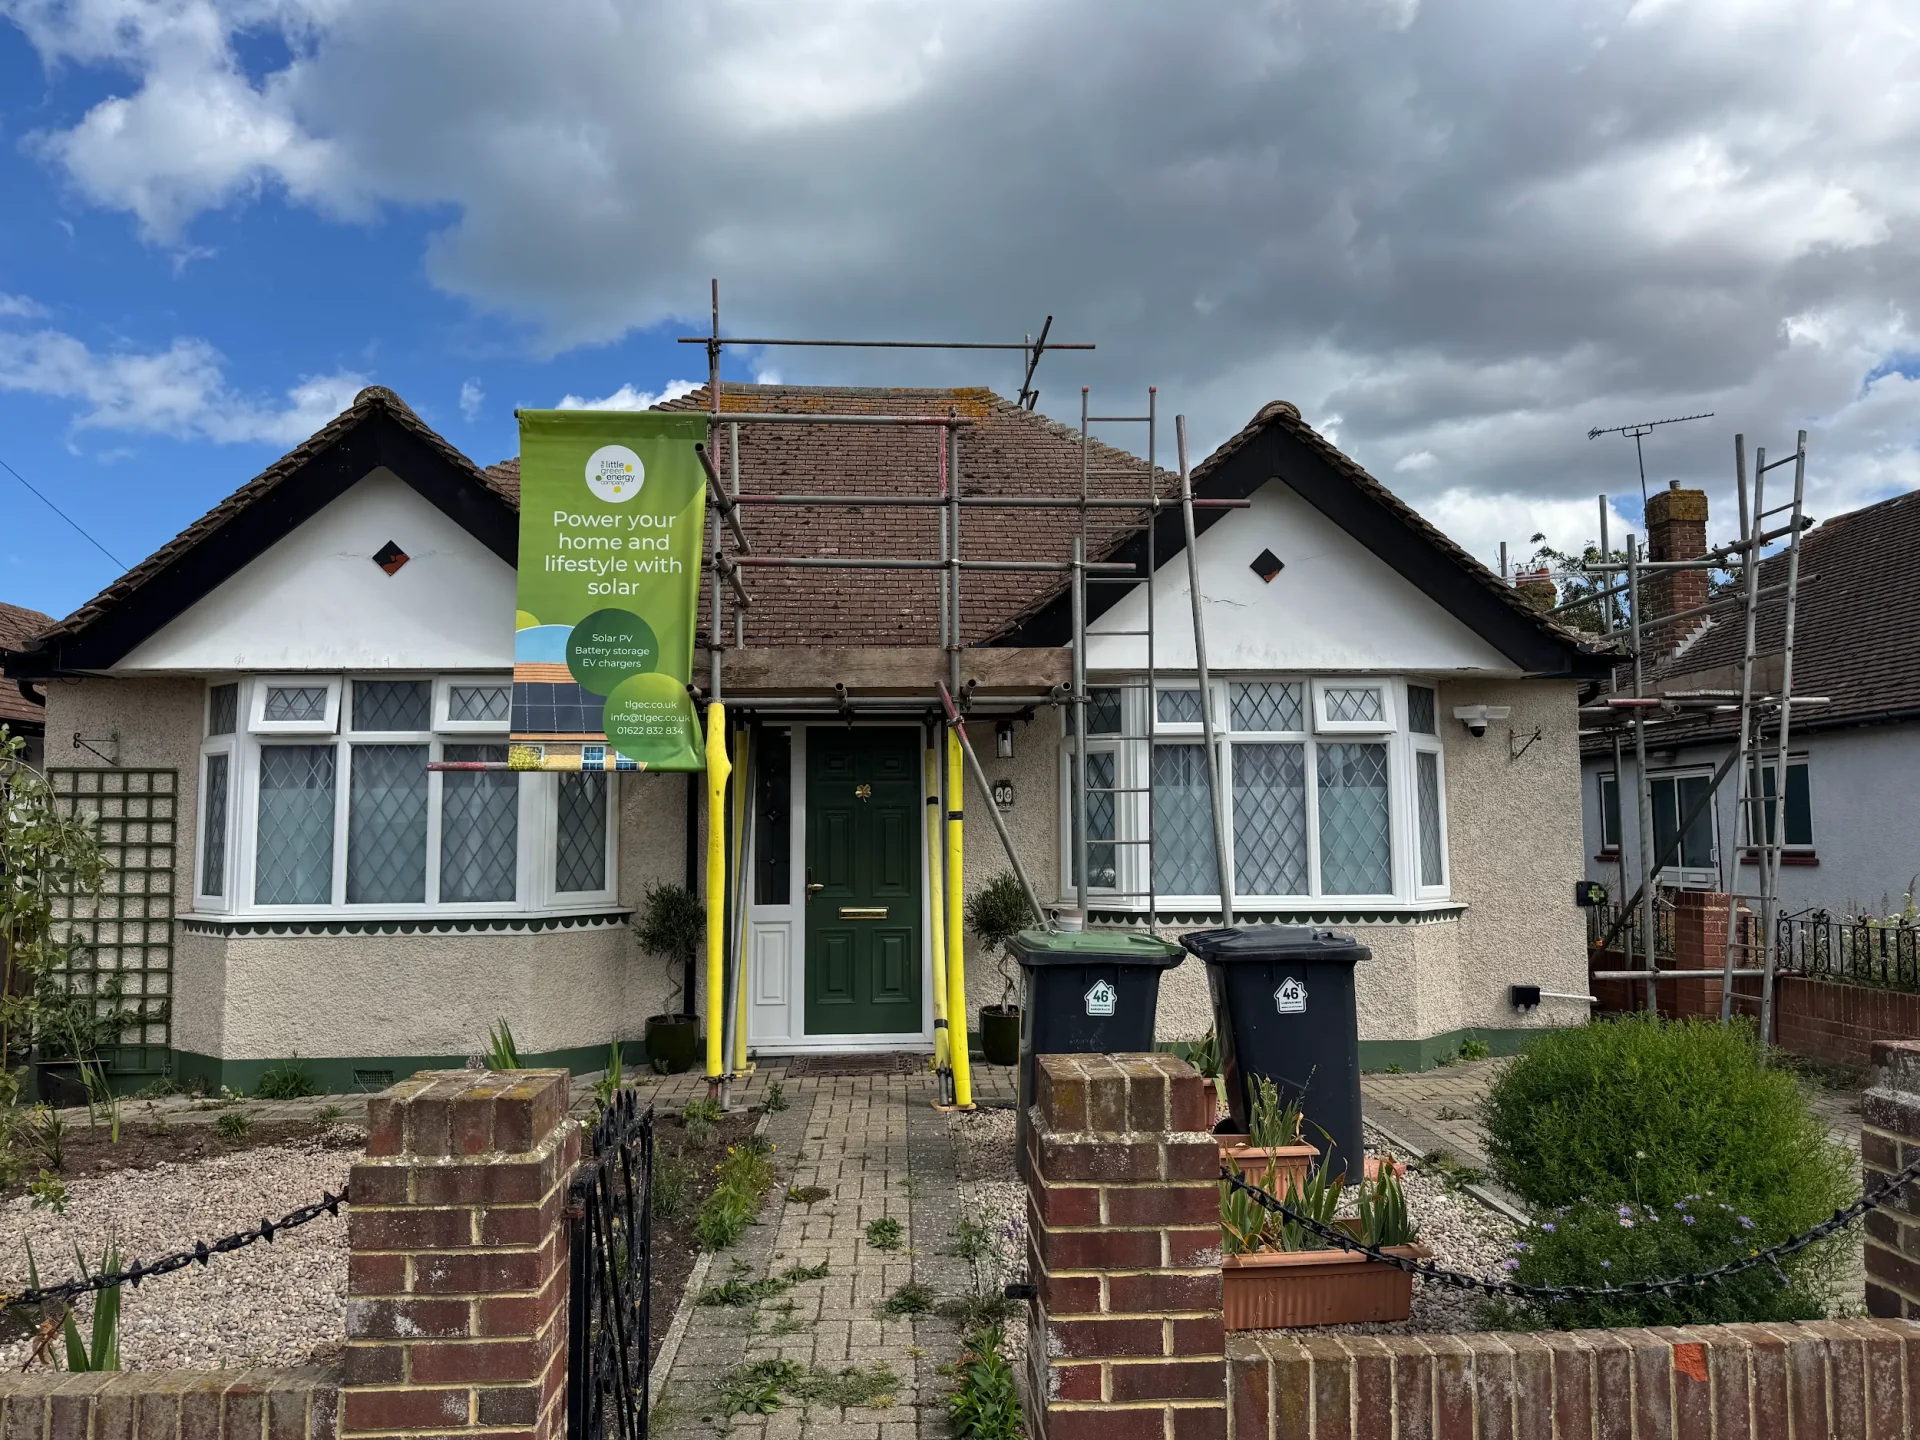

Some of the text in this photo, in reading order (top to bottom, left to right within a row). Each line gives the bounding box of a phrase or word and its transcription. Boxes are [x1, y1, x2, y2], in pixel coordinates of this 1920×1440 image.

[606, 460, 625, 469] little
[600, 468, 625, 476] green
[606, 474, 635, 483] energy
[553, 510, 676, 531] Power your
[558, 532, 670, 550] home and
[545, 554, 682, 576] lifestyle with
[587, 578, 639, 595] solar
[592, 633, 633, 643] Solar PV
[575, 646, 650, 657] Battery storage
[582, 658, 641, 669] EV chargers
[625, 700, 677, 710] tlgec.co.uk
[610, 713, 691, 723] info@tlgec.co.uk
[617, 726, 684, 735] 01622 832 834
[996, 789, 1011, 800] 46
[1092, 989, 1109, 1003] 46
[1282, 987, 1299, 1000] 46
